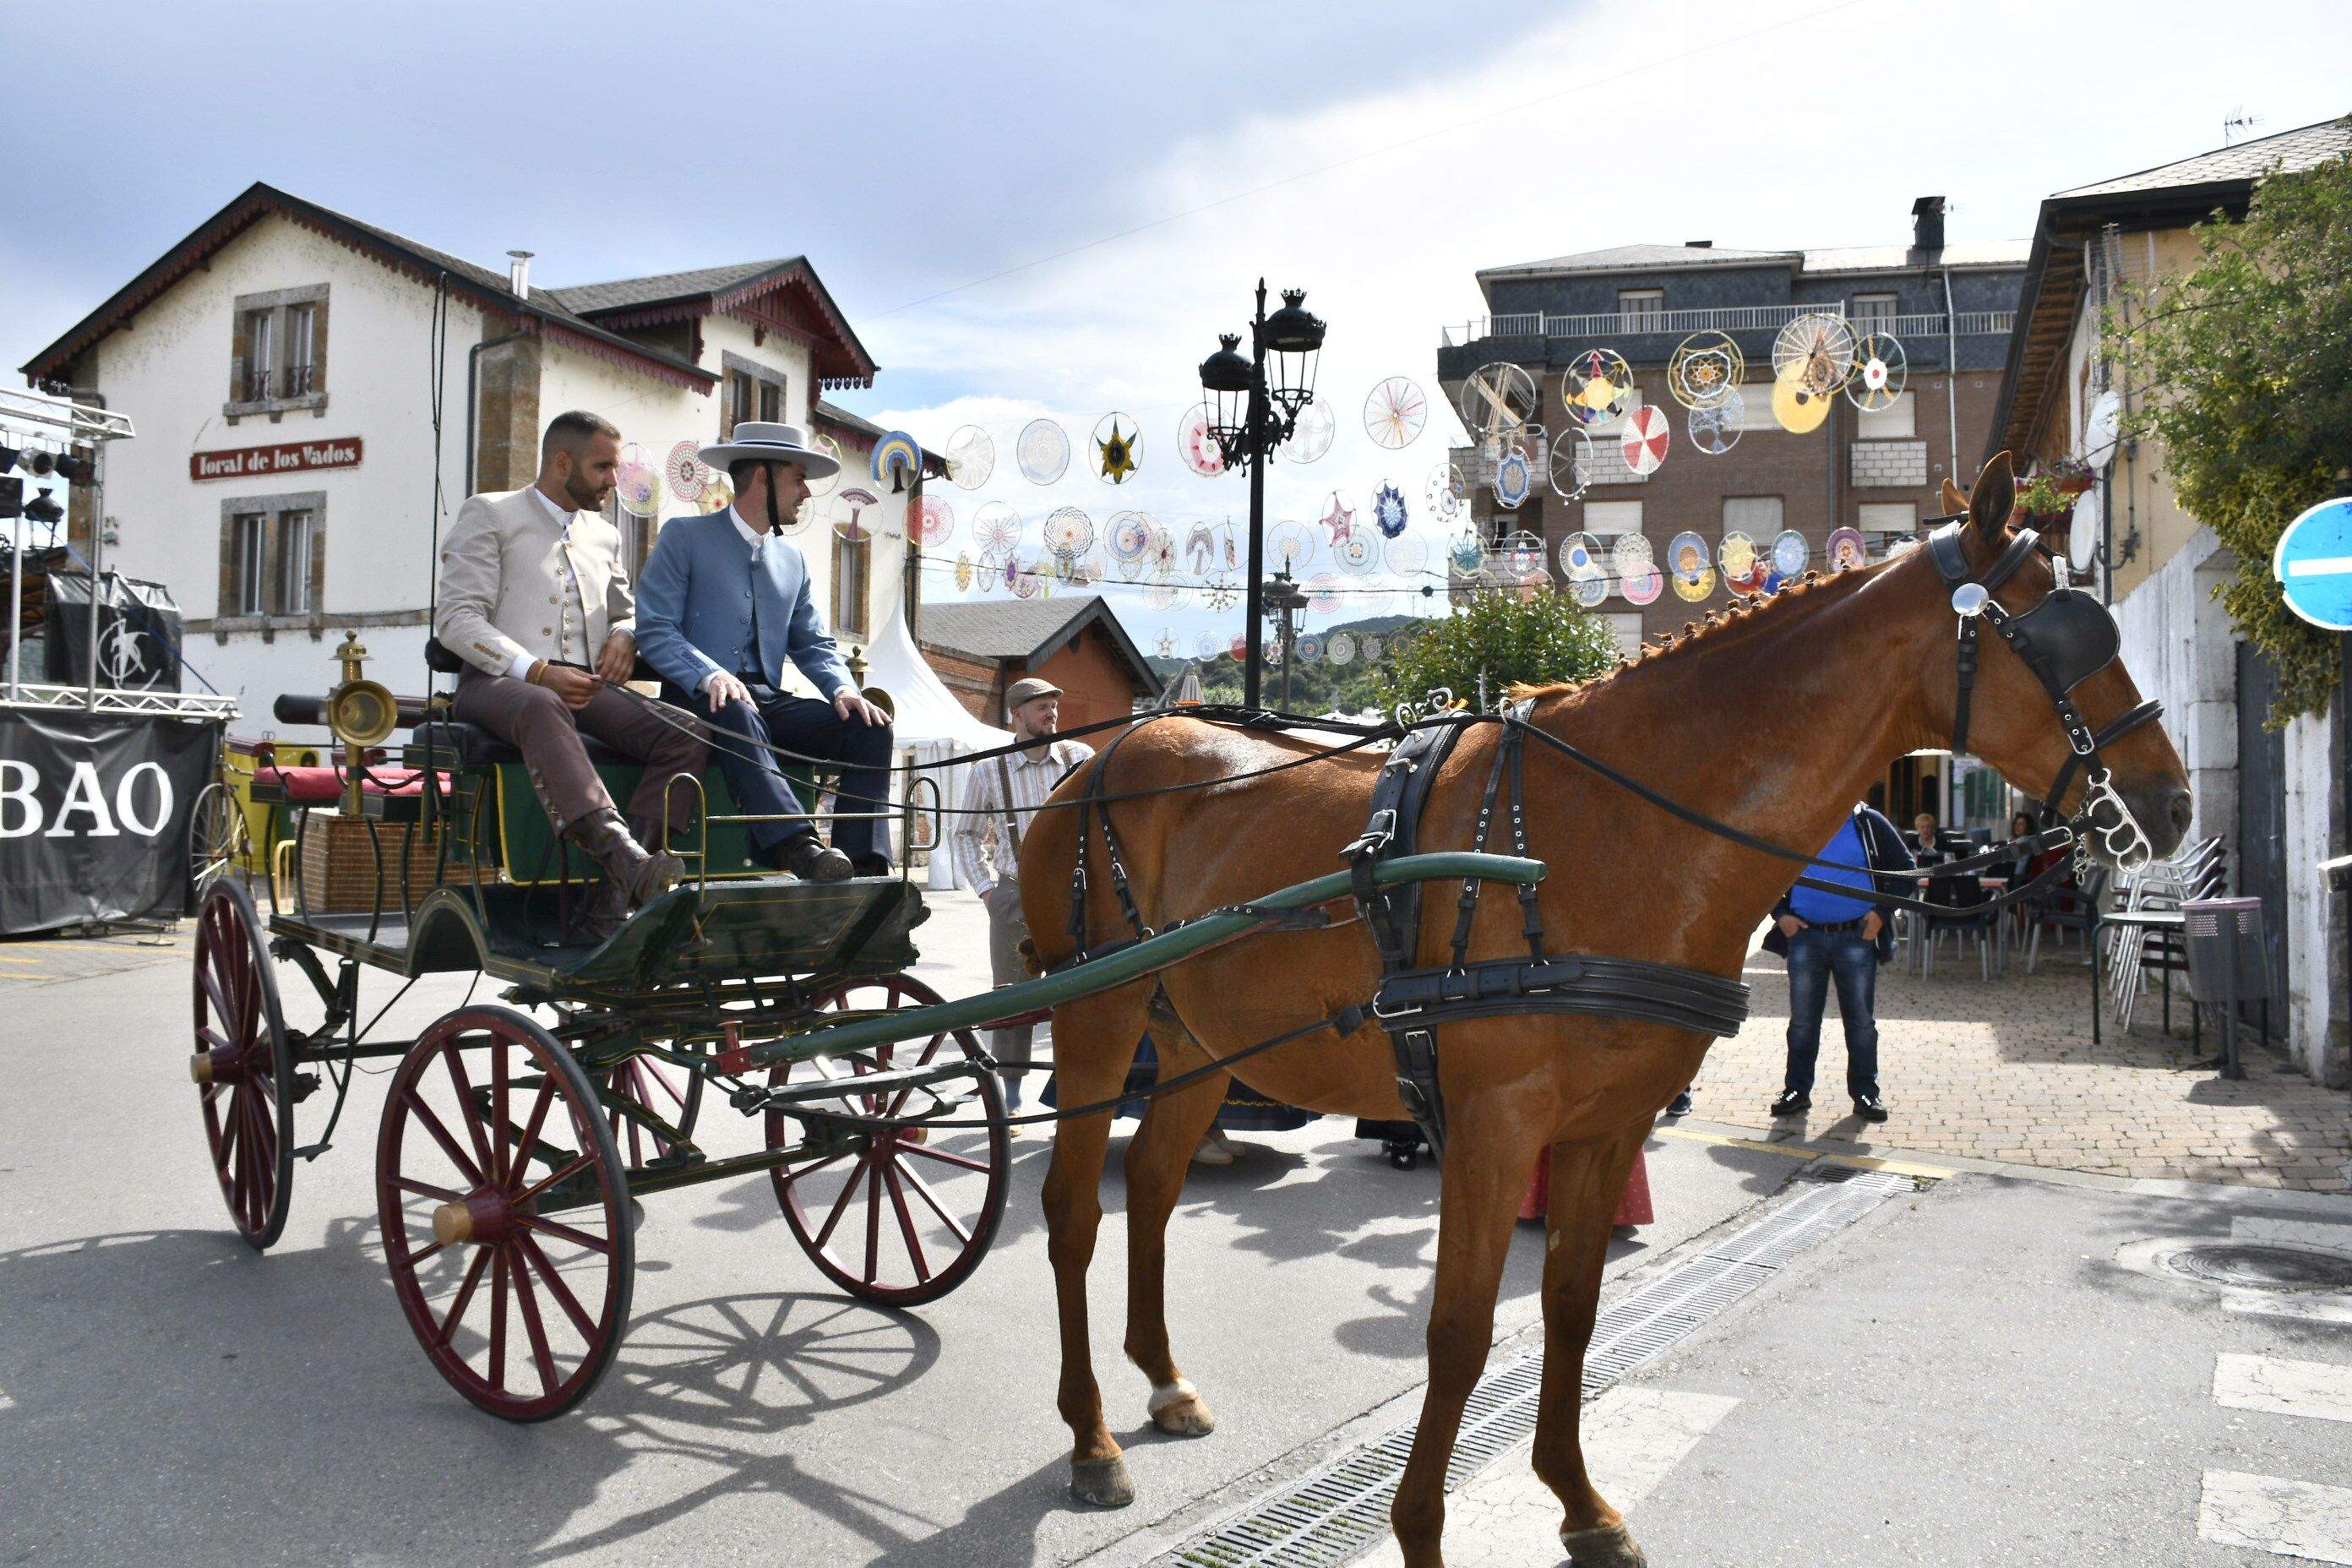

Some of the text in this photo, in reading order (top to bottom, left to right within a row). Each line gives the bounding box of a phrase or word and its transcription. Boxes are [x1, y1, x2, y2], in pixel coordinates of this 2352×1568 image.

[199, 444, 355, 475] Toral de los Vados
[0, 760, 174, 838] BAO
